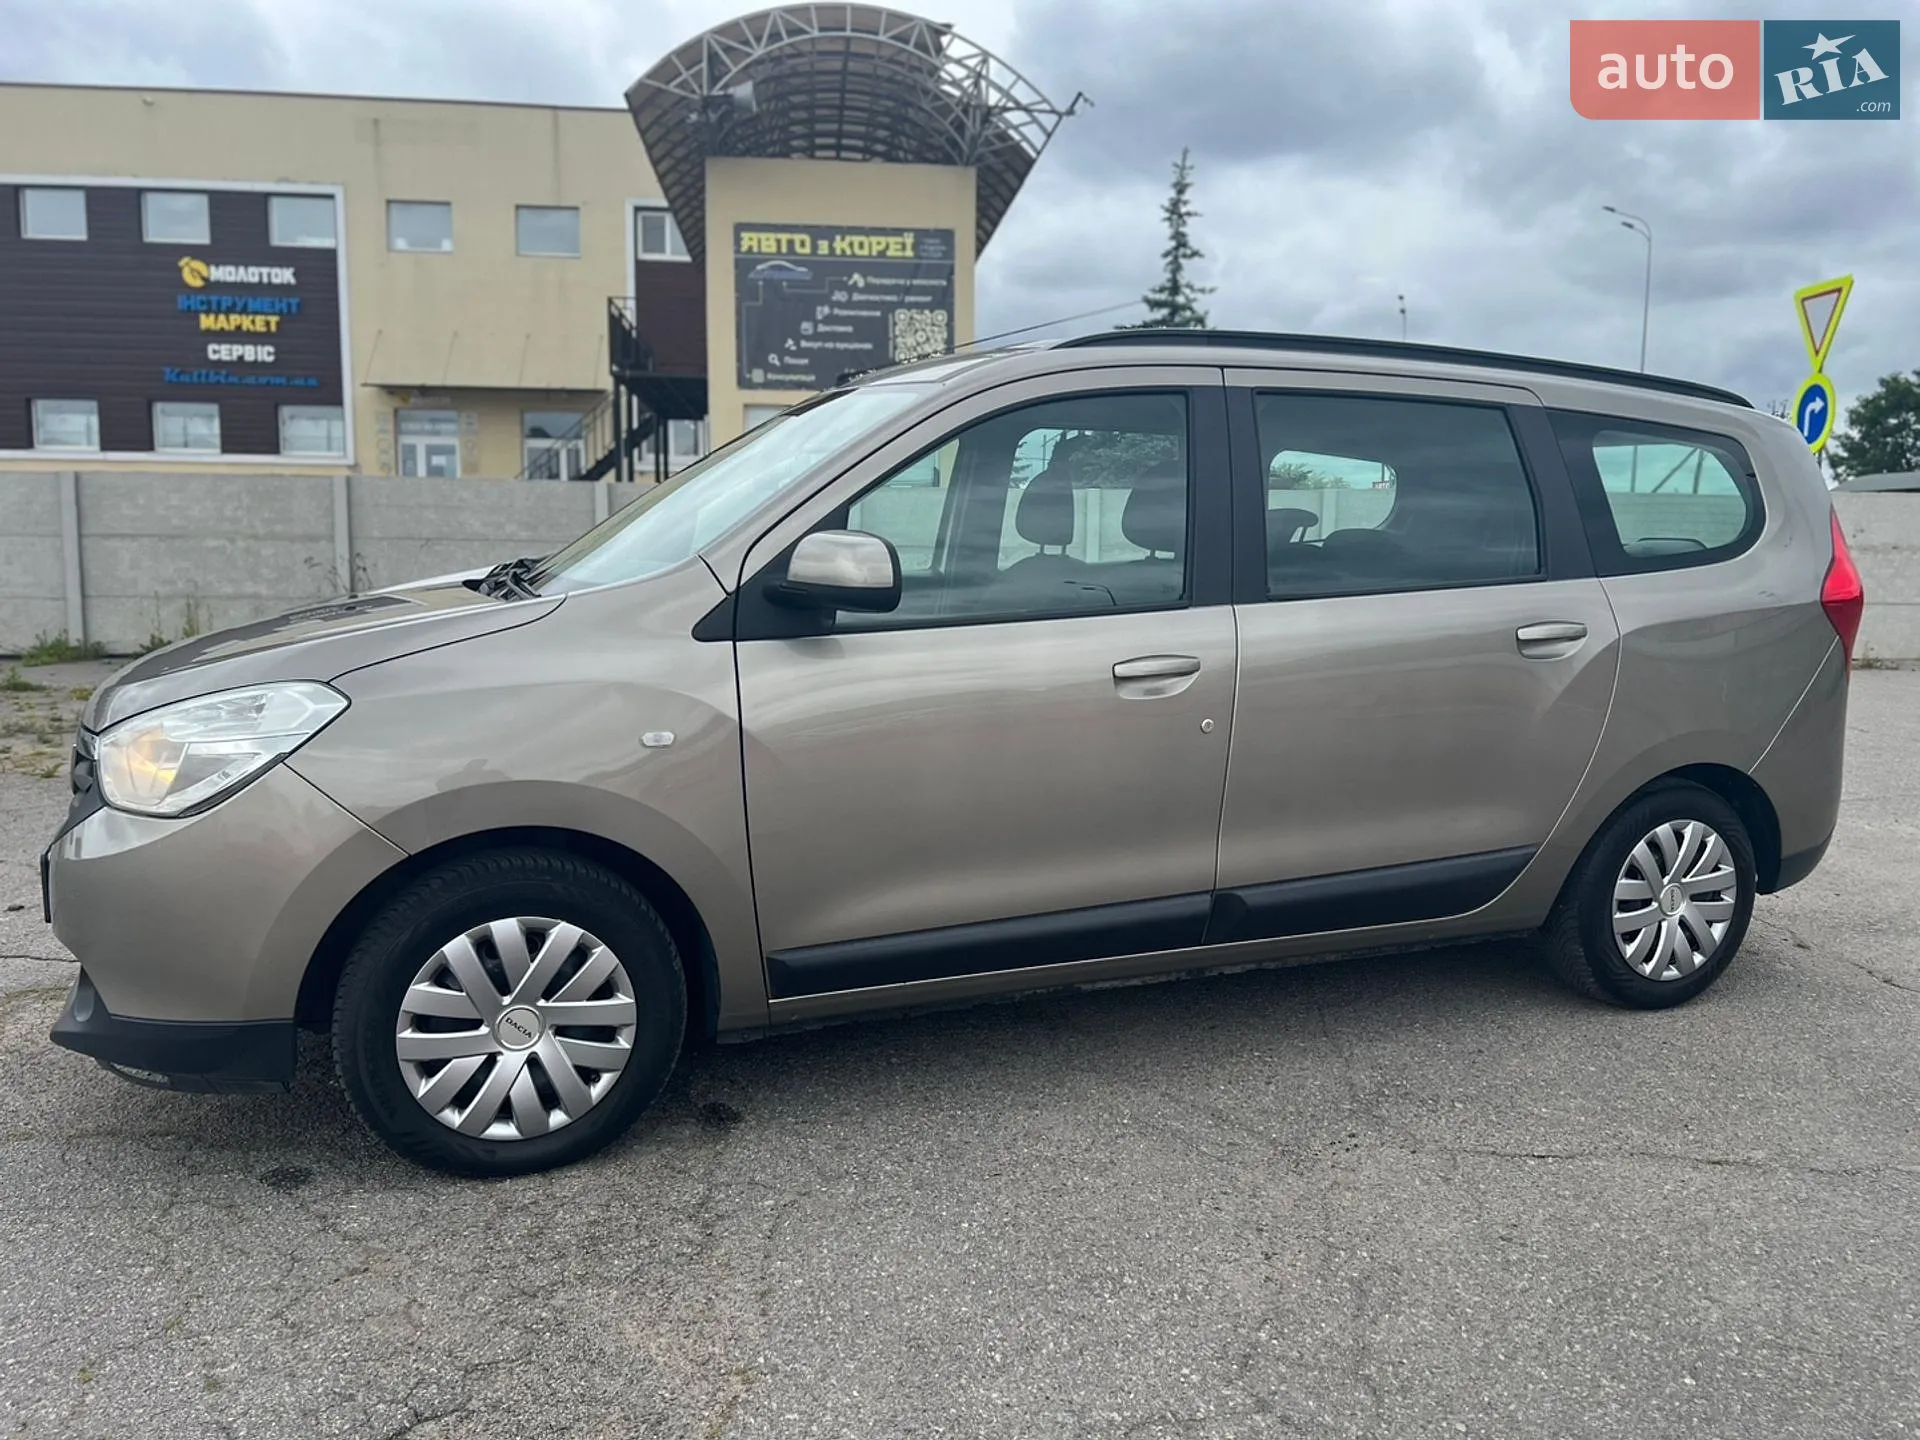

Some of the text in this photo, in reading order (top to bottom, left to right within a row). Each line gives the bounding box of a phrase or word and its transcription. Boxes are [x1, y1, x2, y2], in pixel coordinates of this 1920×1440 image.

[740, 231, 811, 255] АВТО
[833, 232, 915, 257] КОРЕЇ
[208, 264, 296, 285] МОЛОТОК
[177, 294, 301, 315] ІНСТРУМЕНТ
[200, 313, 280, 332] МАРКЕТ
[207, 343, 276, 362] СЕРВІС
[505, 1017, 532, 1038] DACIA
